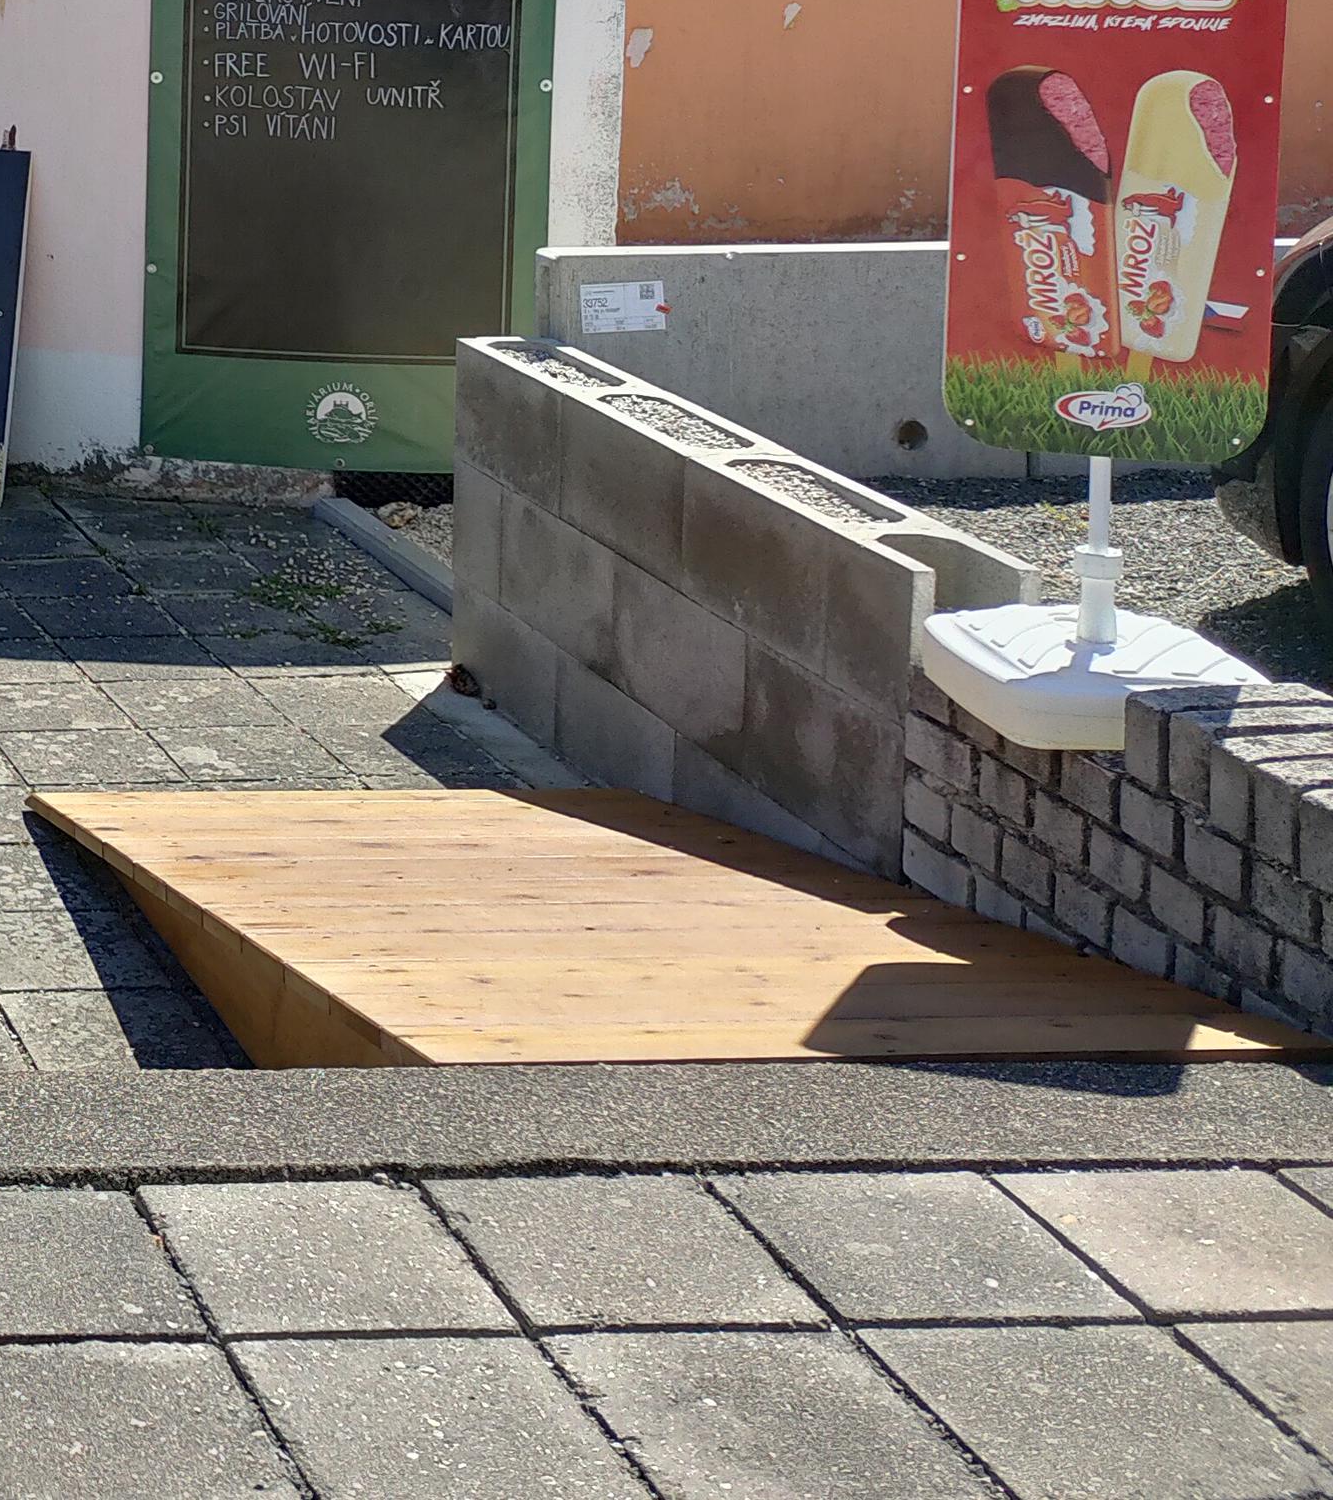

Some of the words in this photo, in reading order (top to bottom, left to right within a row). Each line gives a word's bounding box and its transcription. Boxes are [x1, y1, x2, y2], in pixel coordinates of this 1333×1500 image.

[213, 2, 313, 26] GRILOVÁNÍ
[214, 22, 285, 42] PLATBA
[301, 21, 420, 47] HOTOVOSTI
[438, 23, 511, 50] KARTOU
[214, 52, 271, 78] FREE
[298, 52, 376, 80] WI-FI
[214, 85, 342, 112] KOLOSTAV
[365, 79, 446, 109] UVNITŘ
[214, 115, 247, 138] PSI
[265, 111, 337, 141] VÍTÁNI
[1017, 231, 1061, 313] MROŽ
[1119, 218, 1157, 298] MROŽ
[1079, 400, 1136, 418] Prima
